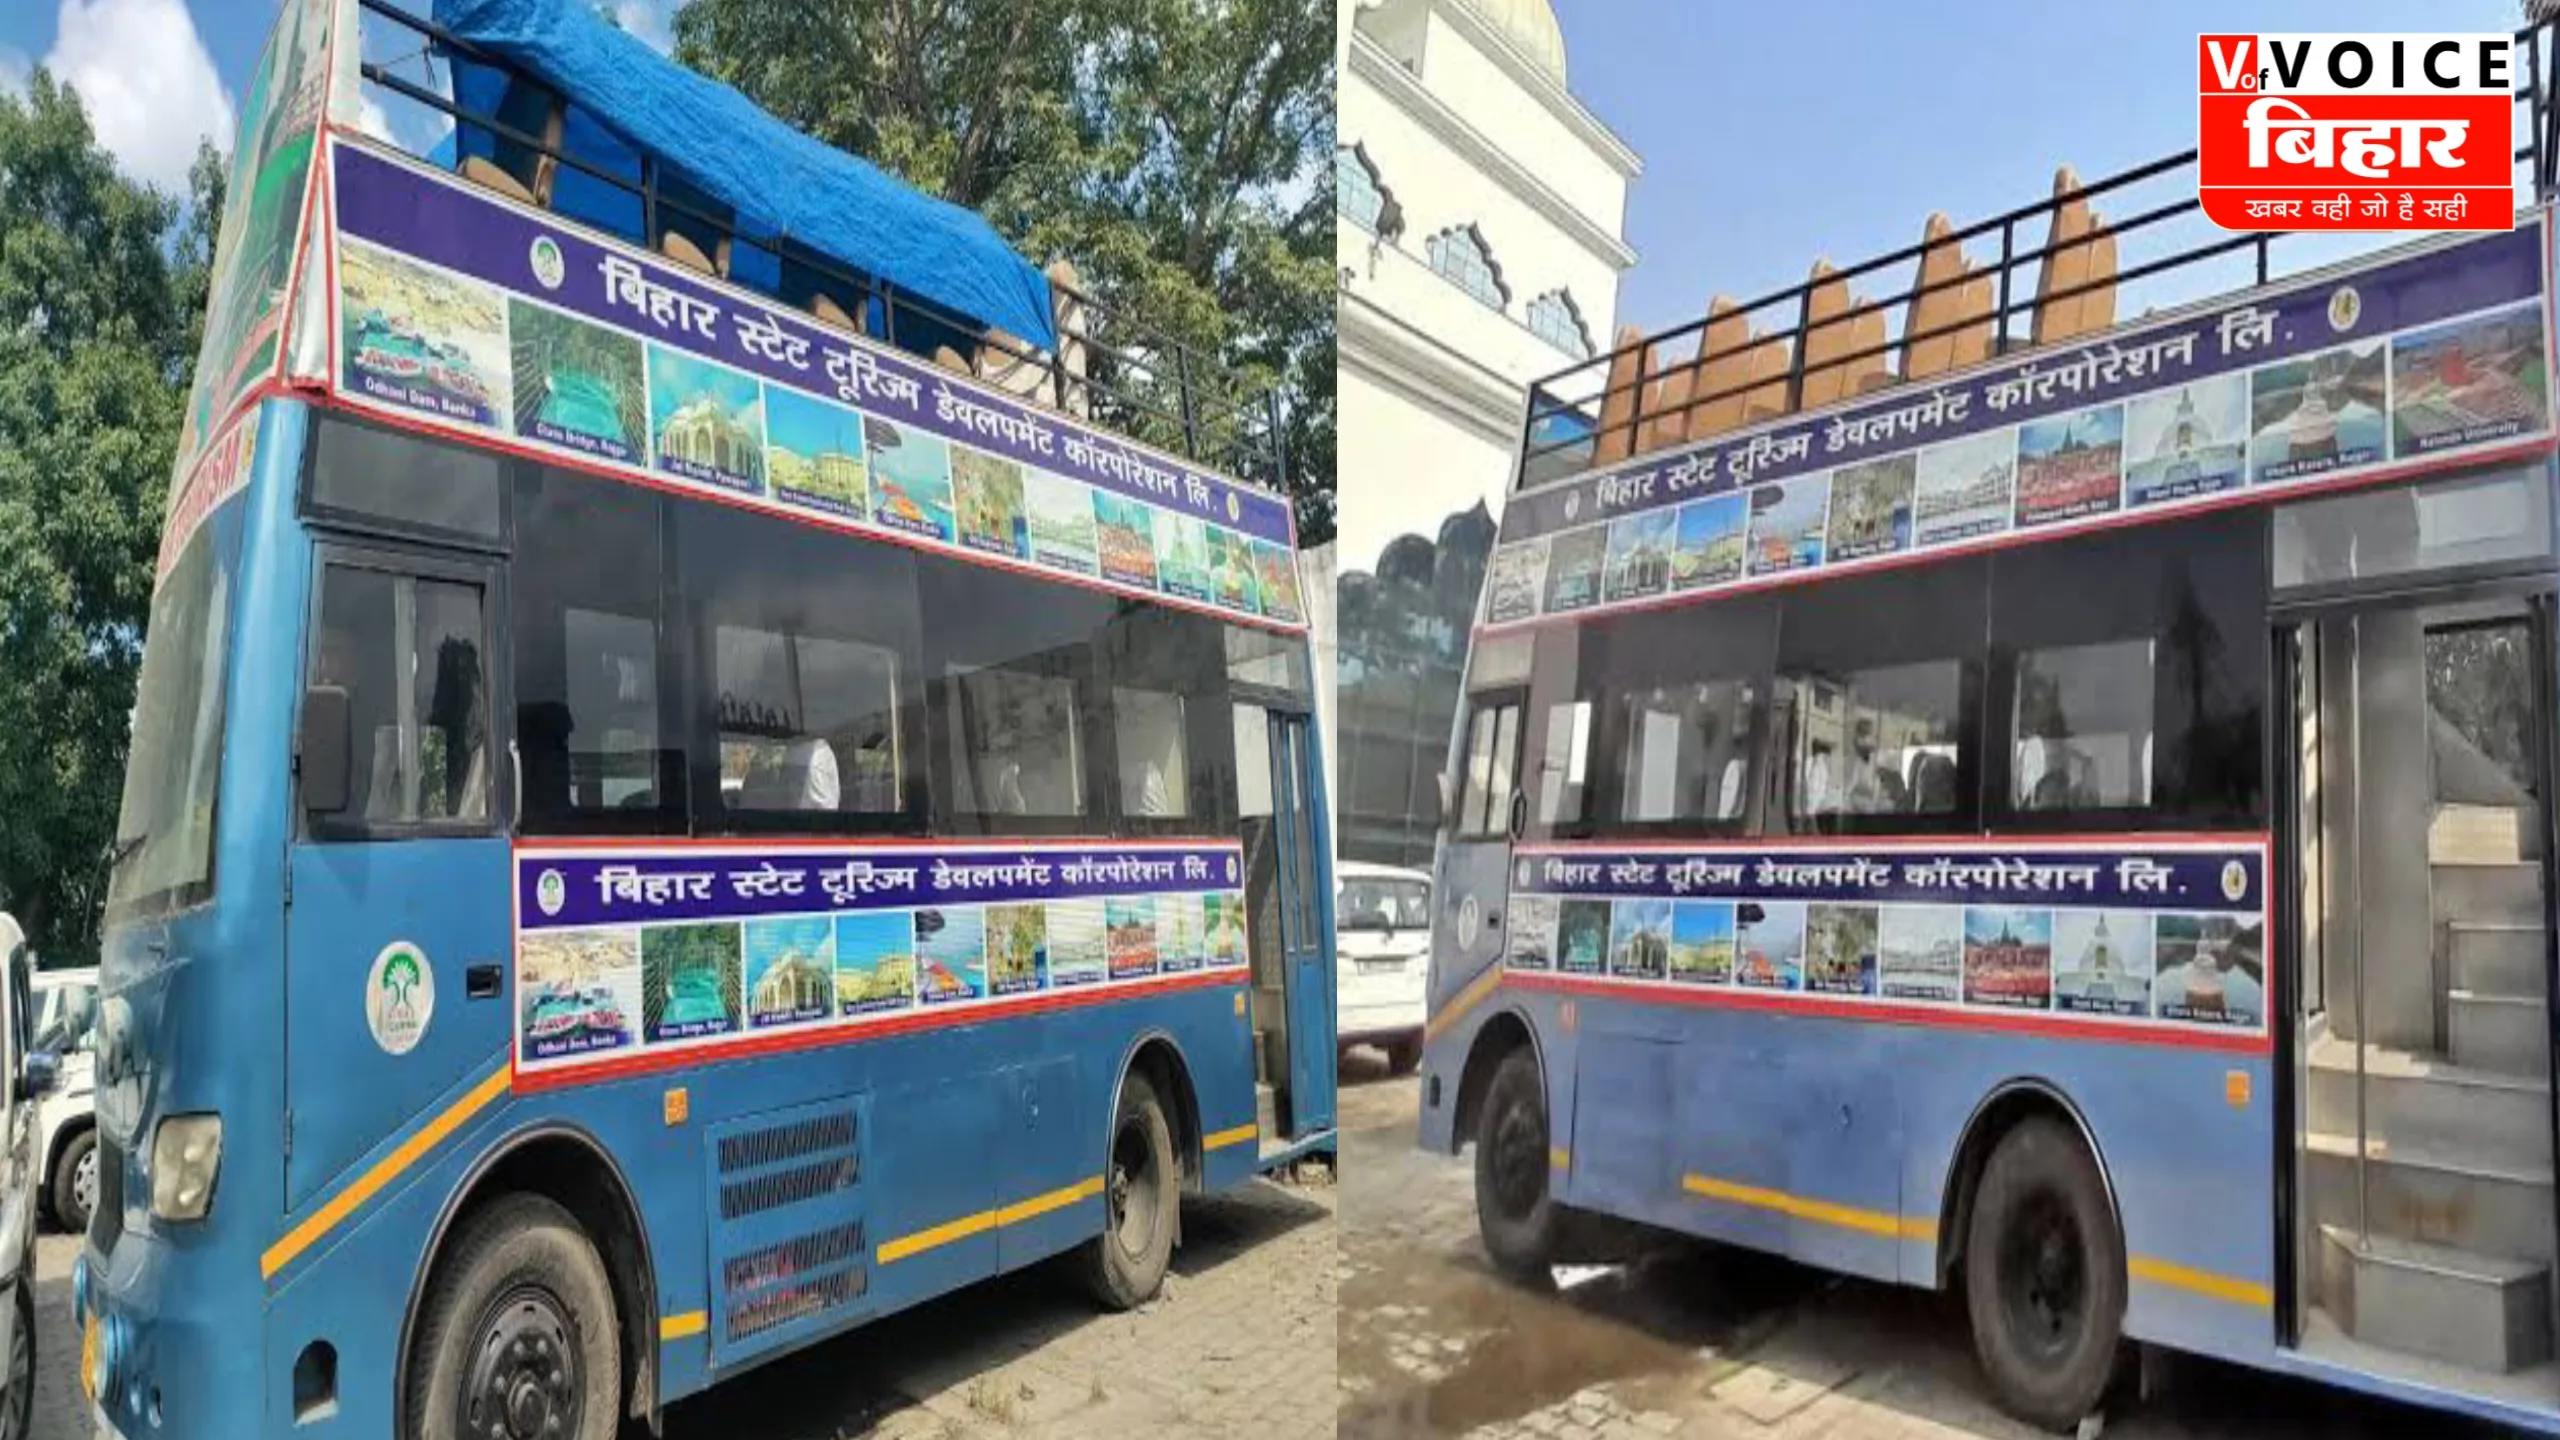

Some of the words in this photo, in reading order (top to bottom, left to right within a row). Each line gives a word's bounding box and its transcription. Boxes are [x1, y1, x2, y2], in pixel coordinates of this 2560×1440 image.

[598, 254, 721, 339] बिहार
[732, 313, 810, 371] स्टेट
[822, 347, 921, 411] टूरिज्म
[932, 381, 1055, 455] डेवलपमेंट
[1062, 434, 1178, 498] कॉरपोरेशन
[1596, 470, 1658, 508] बिहार
[1666, 453, 1717, 492] स्टेट
[1727, 432, 1813, 483] टूरिज्म
[1825, 388, 1973, 452] डेवलपमेंट
[1985, 328, 2199, 412] कॉरपोरेशन
[594, 864, 714, 904] बिहार
[729, 862, 806, 896] स्टेट
[819, 861, 918, 903] टूरिज्म
[930, 856, 1052, 889] डेवलपमेंट
[1059, 855, 1176, 885] कॉरपोरेशन
[1544, 858, 1601, 885] बिहार
[1610, 856, 1660, 883] स्टेट
[1666, 857, 1741, 891] टूरिज्म
[1756, 857, 1892, 888] डेवलपमेंट
[1904, 856, 2099, 892] कॉरपोरेशन
